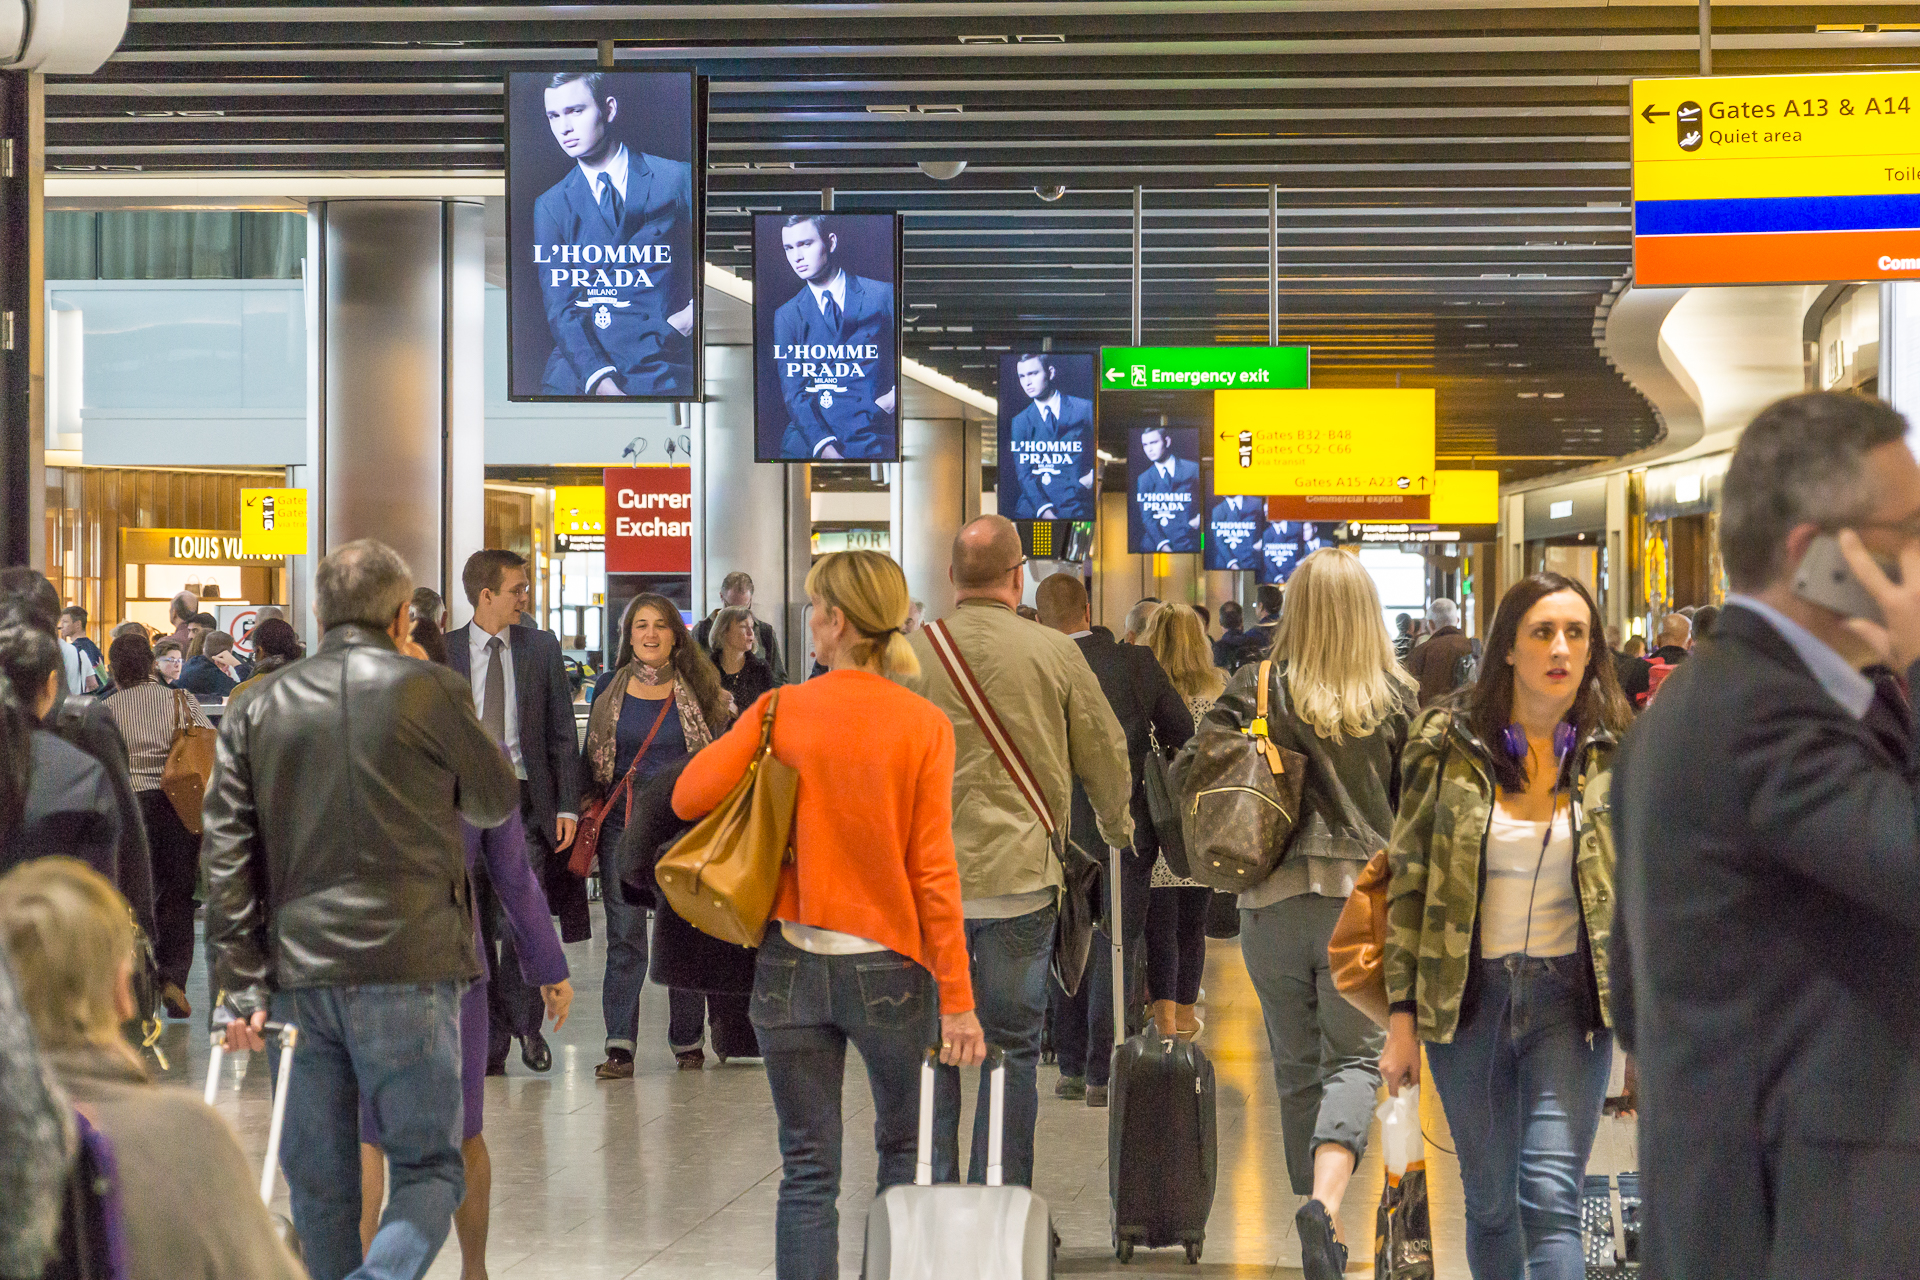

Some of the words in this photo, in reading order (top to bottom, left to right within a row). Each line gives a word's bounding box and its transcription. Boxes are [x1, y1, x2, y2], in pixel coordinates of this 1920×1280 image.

[1709, 101, 1776, 119] Gates
[1784, 98, 1829, 117] A13
[1839, 98, 1855, 116] &
[1864, 96, 1911, 115] A14
[1709, 129, 1758, 146] Quiet
[1763, 131, 1802, 142] area
[533, 244, 672, 264] L'HOMME
[550, 268, 655, 287] PRADA
[586, 288, 618, 296] MILANO
[773, 344, 879, 359] L'HOMME
[786, 362, 865, 377] PRADA
[1151, 368, 1237, 386] Emergency
[1239, 368, 1270, 382] exit
[1256, 430, 1293, 440] Gates
[1010, 440, 1083, 452] L'HOMME
[1256, 444, 1293, 455] Gates
[1019, 453, 1073, 464] PRADA
[1256, 458, 1271, 466] via
[1273, 457, 1306, 466] transit
[1295, 476, 1332, 488] Gates
[617, 488, 692, 509] Curren
[1136, 492, 1192, 502] L'HOMME
[1305, 495, 1364, 503] Commercial
[1366, 495, 1404, 504] exports
[1143, 501, 1185, 511] PRADA
[616, 516, 692, 537] Exchan
[174, 535, 220, 559] LOUIS
